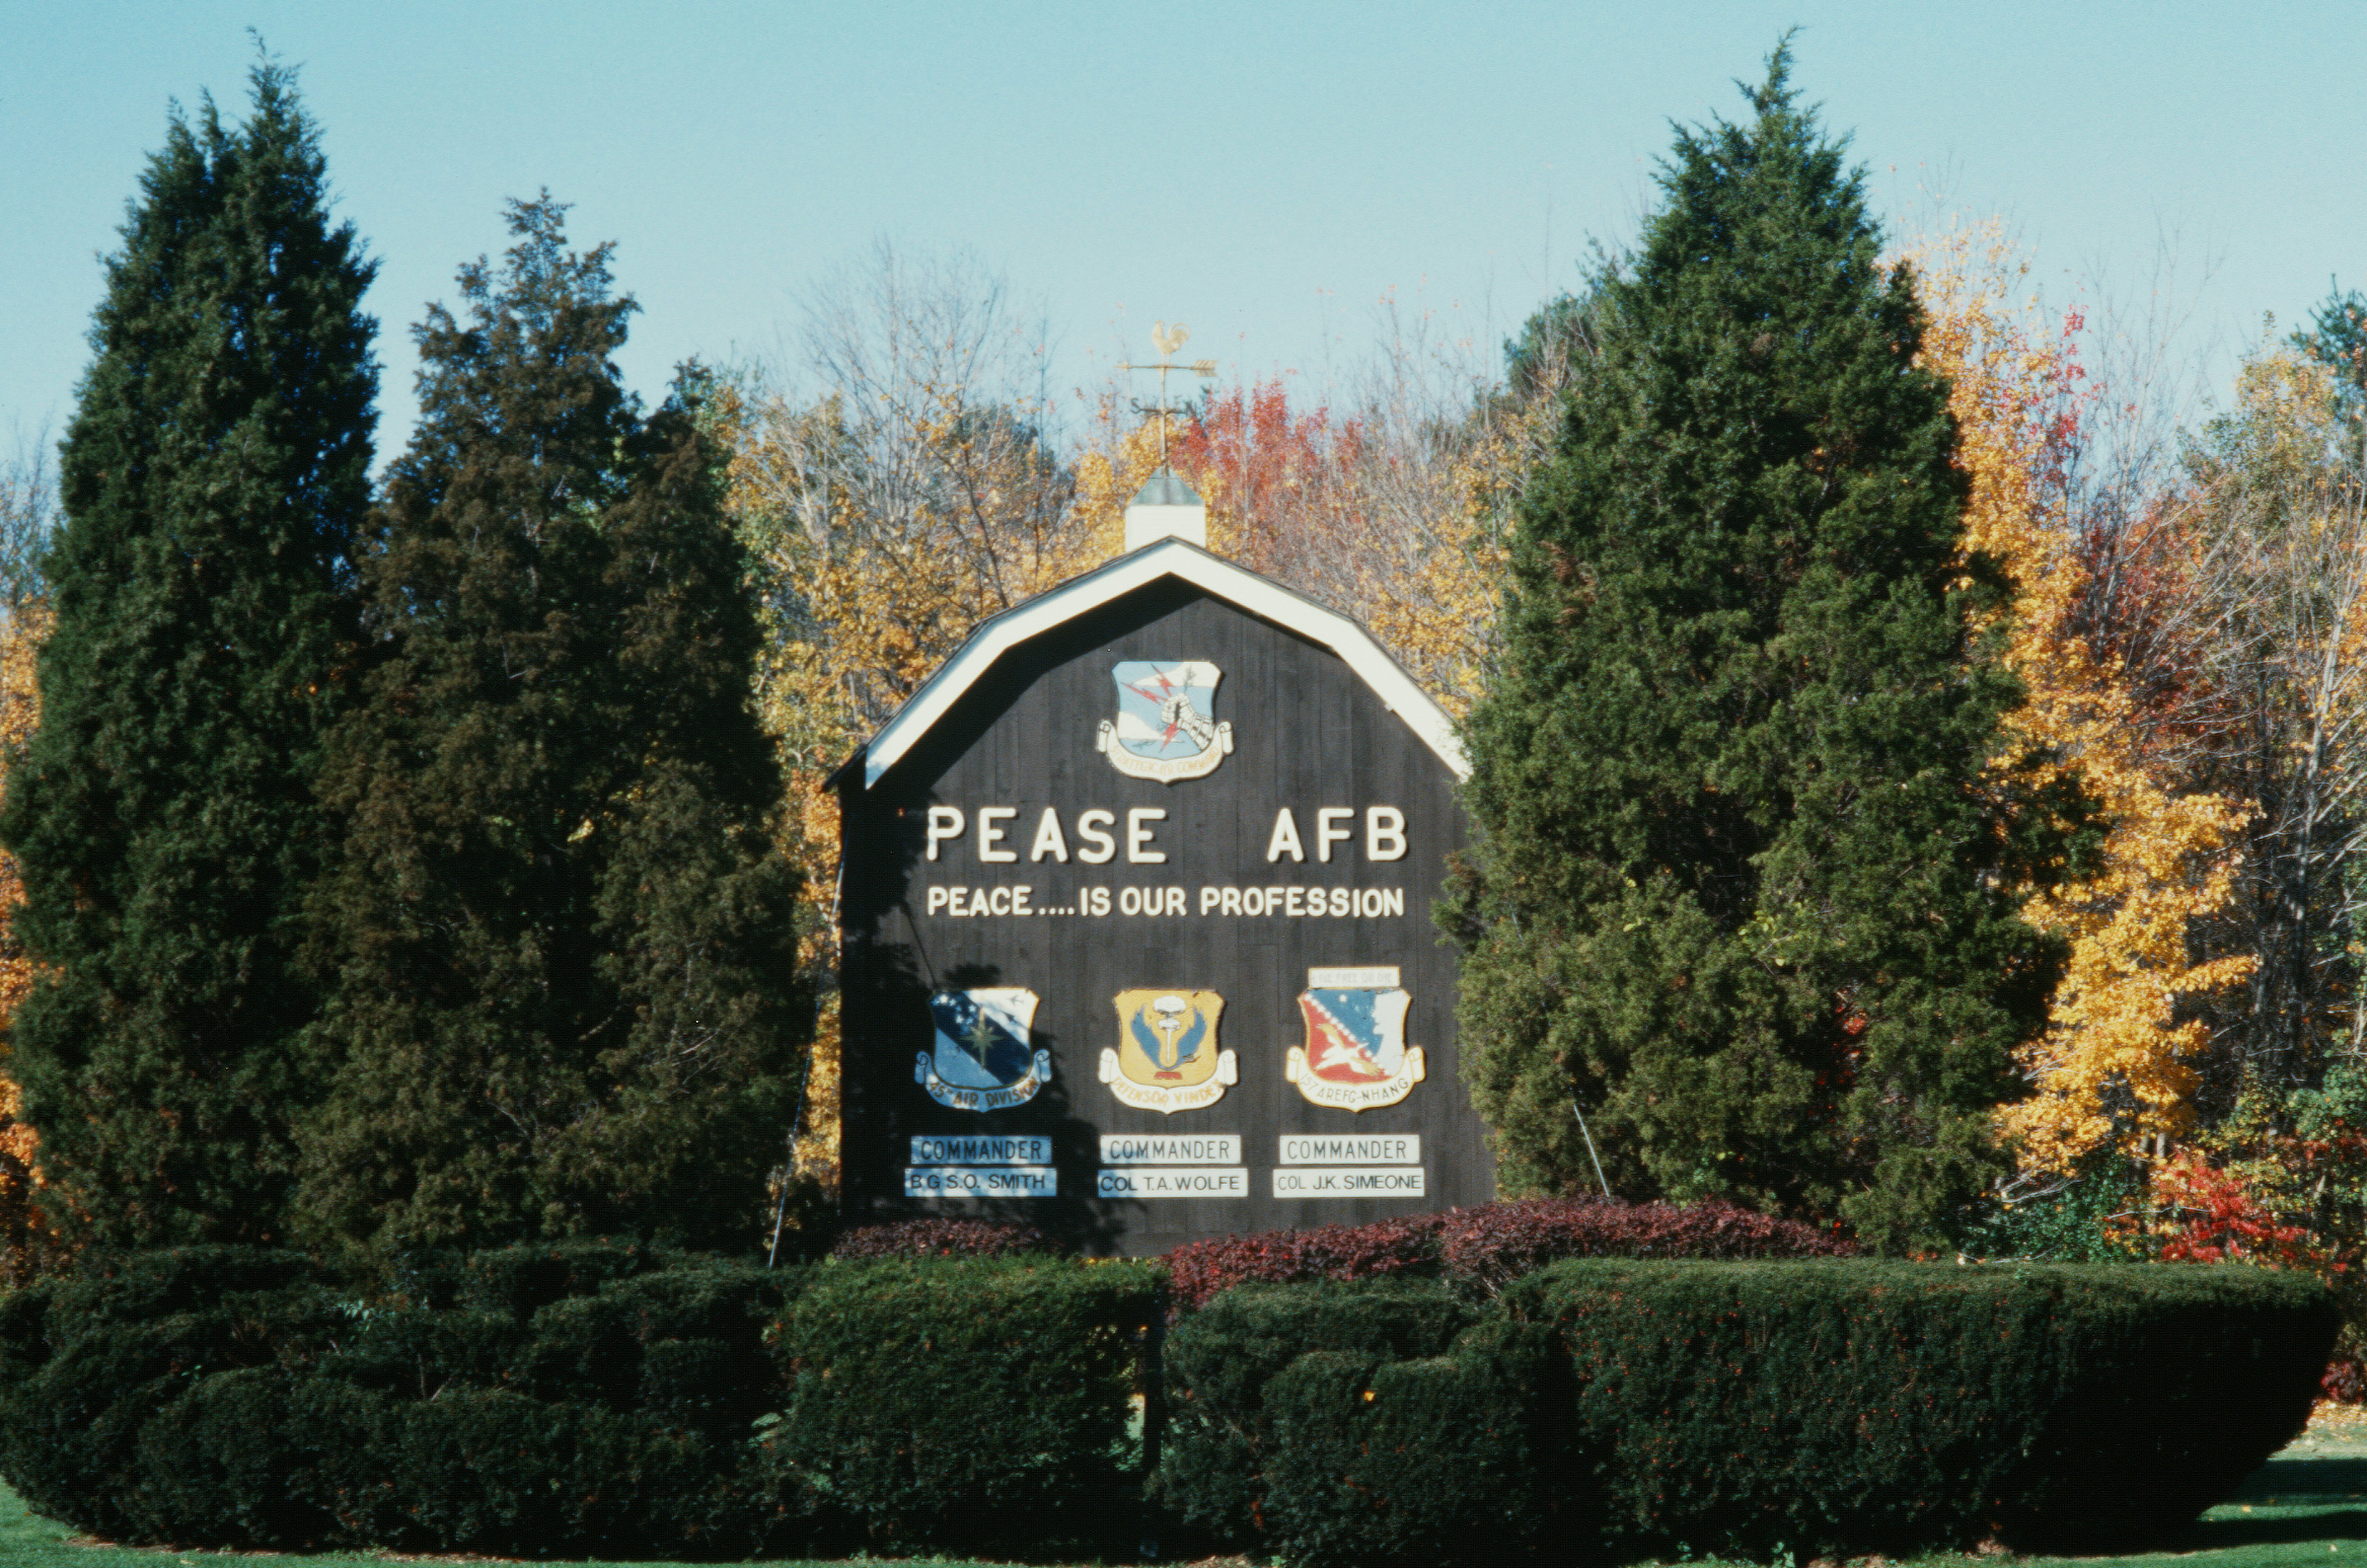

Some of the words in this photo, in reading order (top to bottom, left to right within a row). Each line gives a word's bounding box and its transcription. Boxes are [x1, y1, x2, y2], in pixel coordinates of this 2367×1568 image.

[926, 806, 1166, 864] PEASE
[1266, 806, 1407, 862] AFB
[1119, 886, 1187, 917] OUR
[1200, 886, 1404, 918] PROFESSION
[953, 1090, 979, 1106] AIR
[985, 1075, 1039, 1107] DIVISION
[1300, 1073, 1319, 1091] 157
[1111, 1077, 1169, 1107] DEFENSOR
[1174, 1077, 1222, 1105] VINDEX
[920, 1140, 1042, 1159] COMMANDER
[1110, 1140, 1230, 1159] COMMANDER
[1287, 1140, 1407, 1159] COMMANDER
[946, 1174, 981, 1189] S.O.
[988, 1174, 1045, 1189] SMITH
[1100, 1176, 1138, 1192] COL
[1278, 1176, 1307, 1190] COL
[1343, 1175, 1422, 1190] SIMEONE
